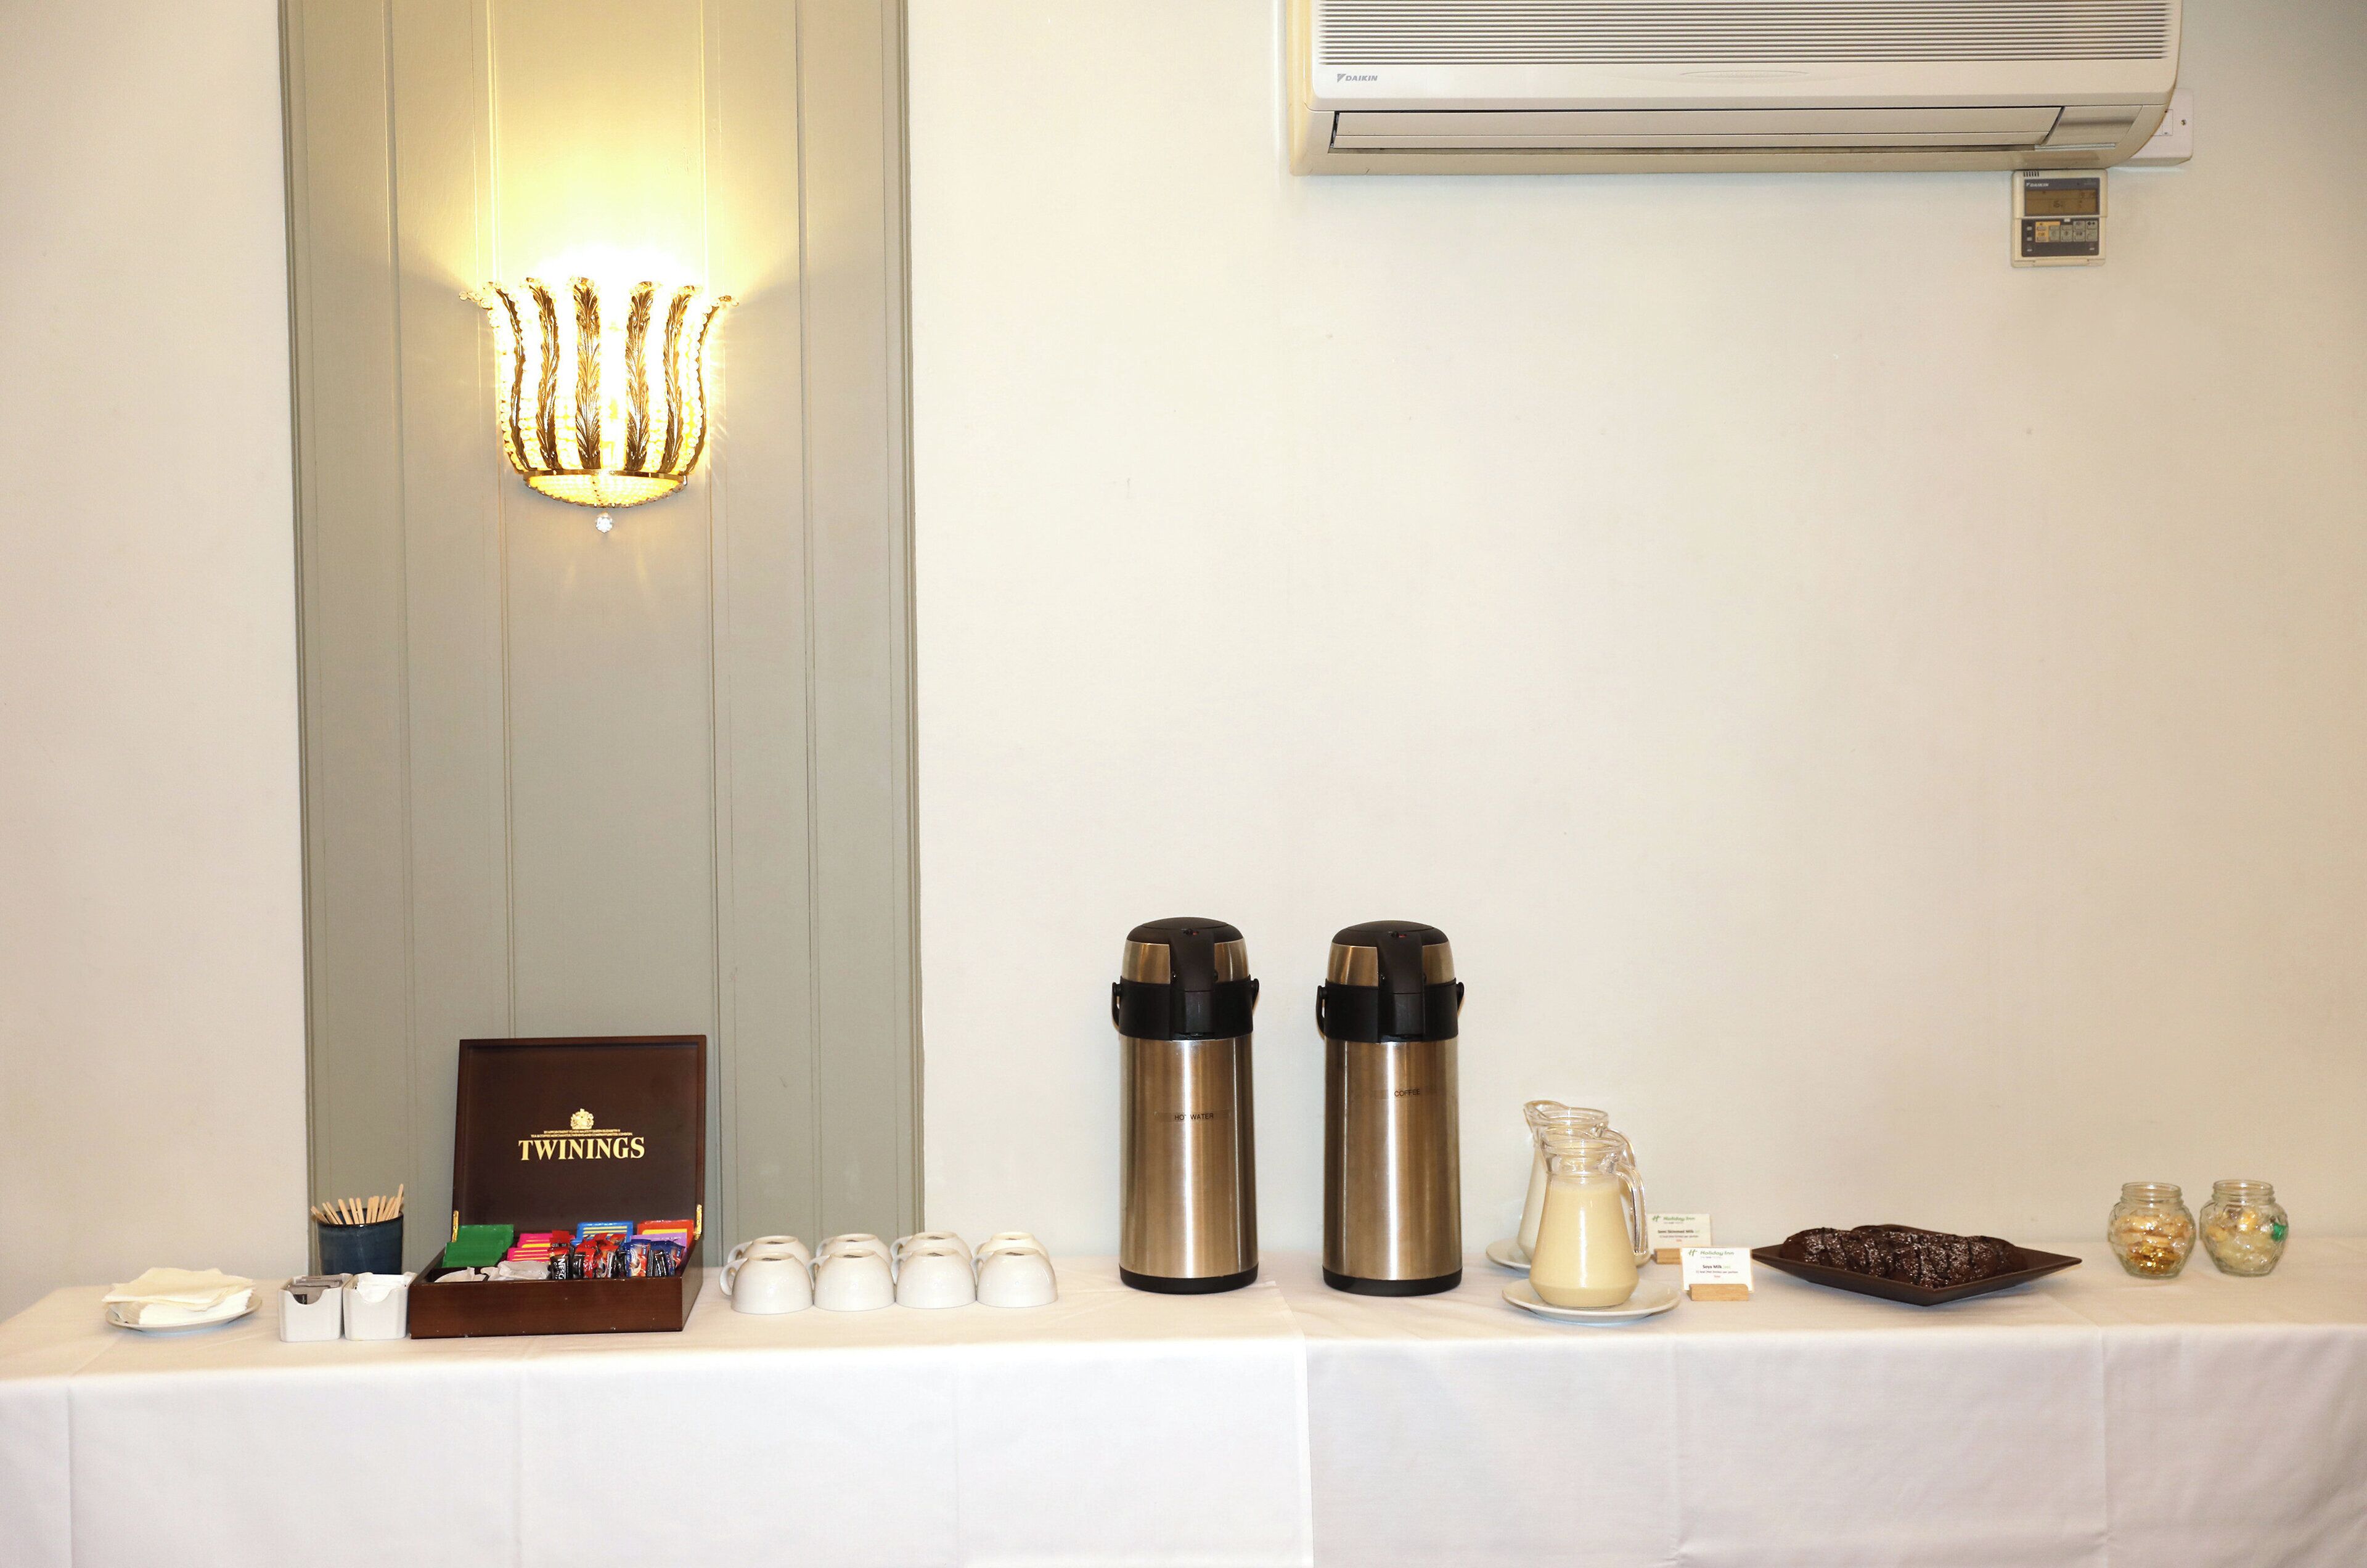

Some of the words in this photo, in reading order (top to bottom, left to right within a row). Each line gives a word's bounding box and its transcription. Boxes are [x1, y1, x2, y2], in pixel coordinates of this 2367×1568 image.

[1394, 1088, 1421, 1097] COFFEE
[1190, 1113, 1214, 1121] WATER
[518, 1137, 645, 1161] TWININGS
